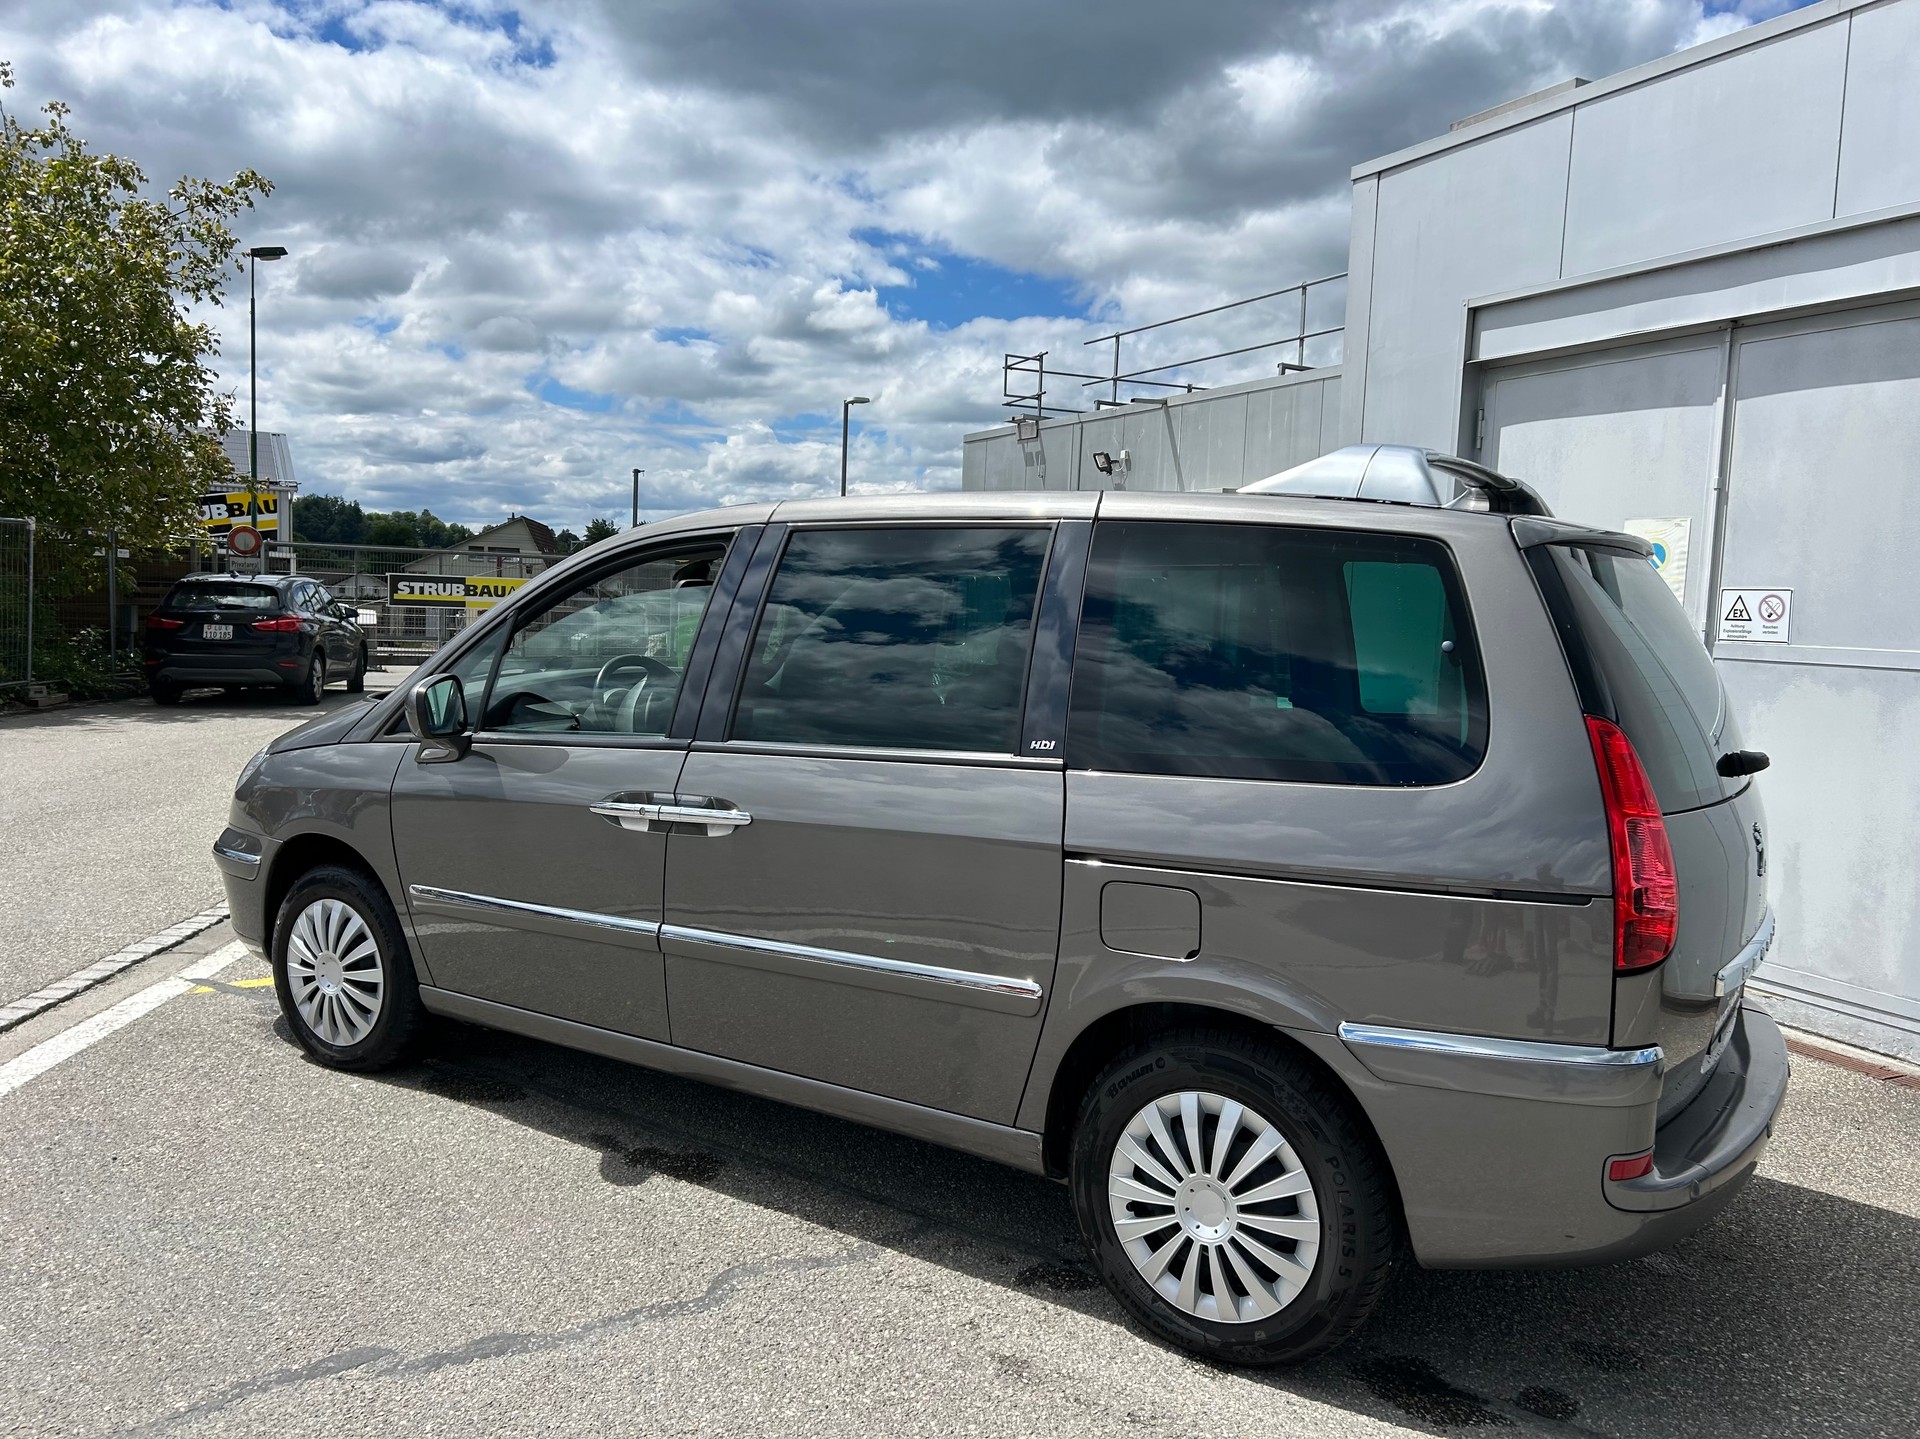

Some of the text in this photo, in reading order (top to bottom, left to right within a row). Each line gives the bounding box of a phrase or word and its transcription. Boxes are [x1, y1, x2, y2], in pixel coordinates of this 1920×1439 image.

[196, 498, 278, 521] UBBAU
[397, 581, 506, 598] STRUBBAU
[1733, 609, 1744, 618] EX
[219, 631, 232, 639] 185
[1325, 1156, 1356, 1278] POLARIS 5
